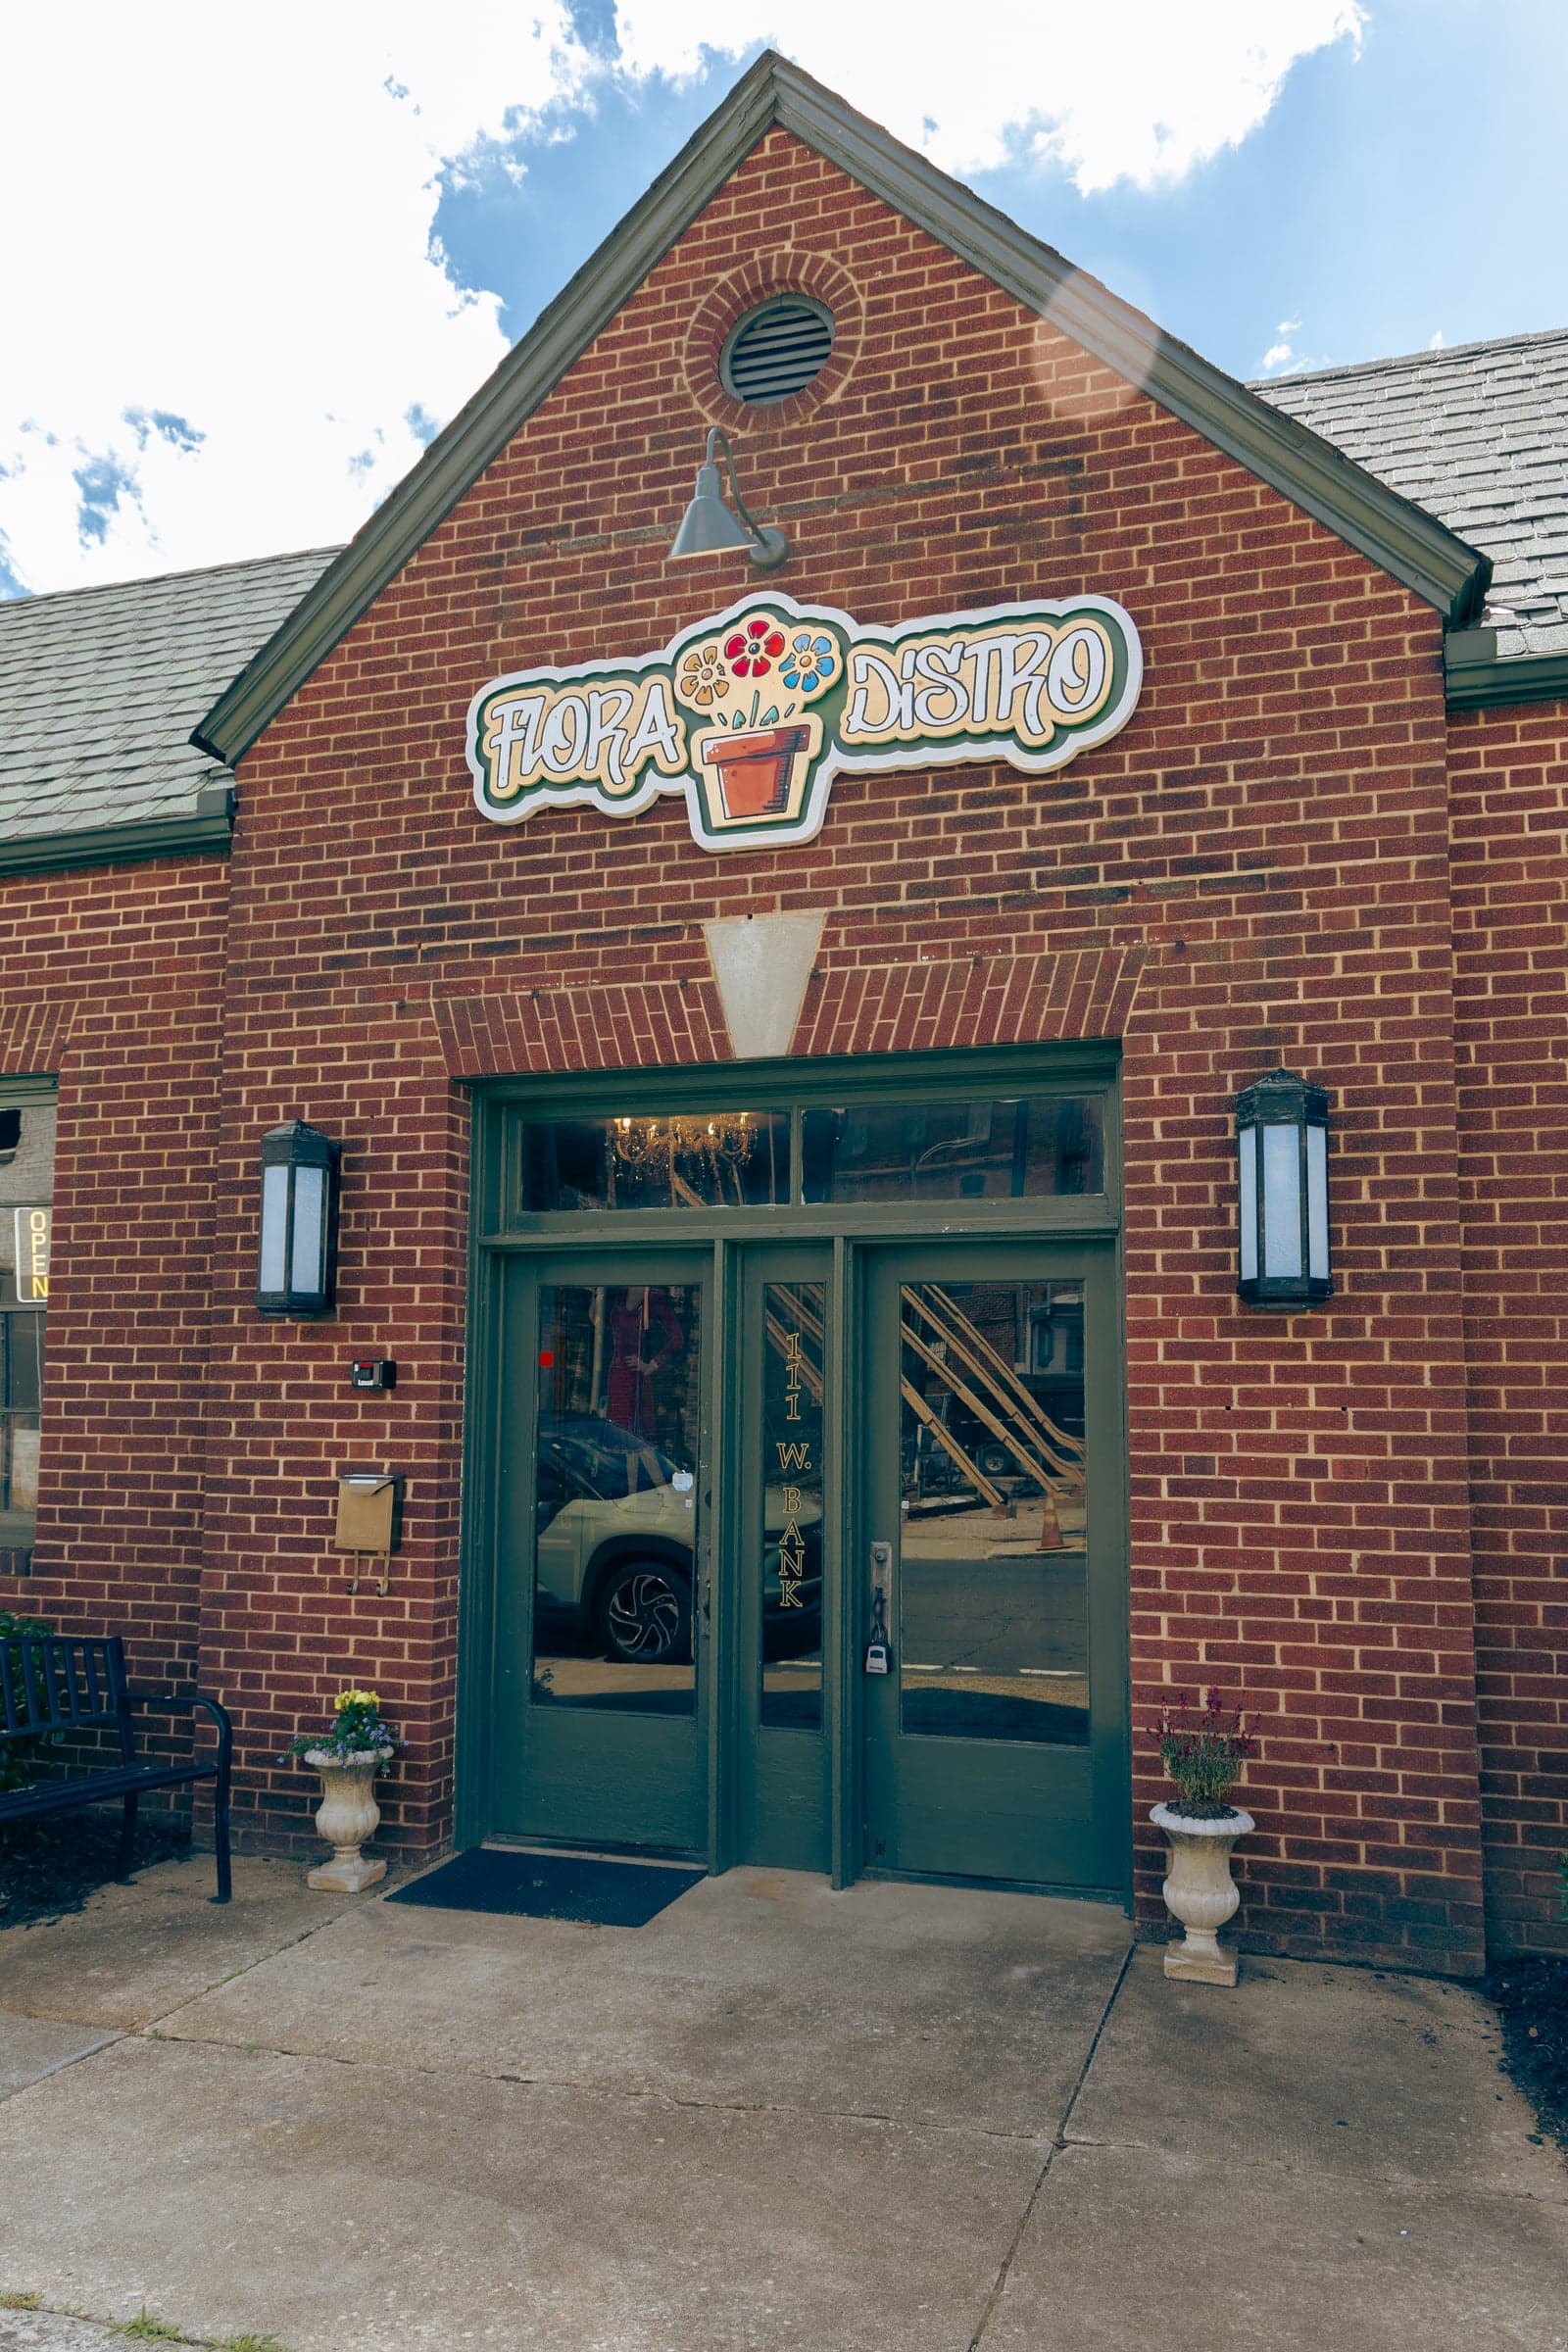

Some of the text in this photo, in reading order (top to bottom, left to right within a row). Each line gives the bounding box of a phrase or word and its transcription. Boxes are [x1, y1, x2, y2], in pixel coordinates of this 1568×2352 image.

[490, 683, 678, 788] FLORA
[30, 1211, 49, 1298] OPEN
[776, 1333, 812, 1607] 111 W. BANK
